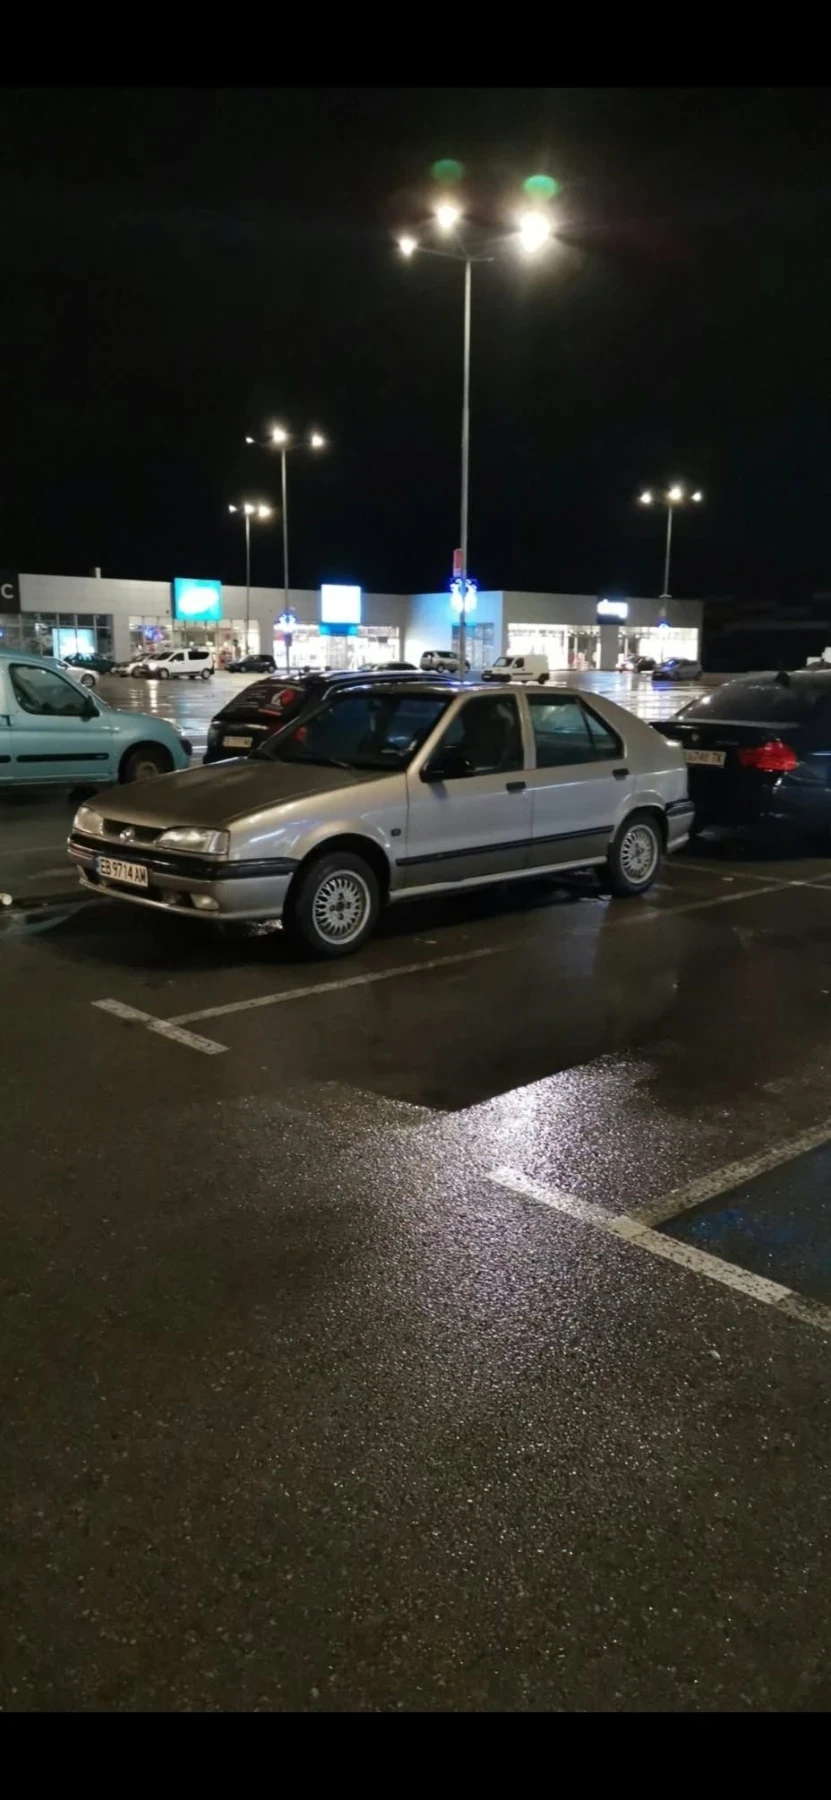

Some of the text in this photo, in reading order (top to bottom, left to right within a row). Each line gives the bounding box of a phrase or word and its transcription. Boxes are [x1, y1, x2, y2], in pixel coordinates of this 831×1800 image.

[101, 859, 146, 883] EB 9714 AM
